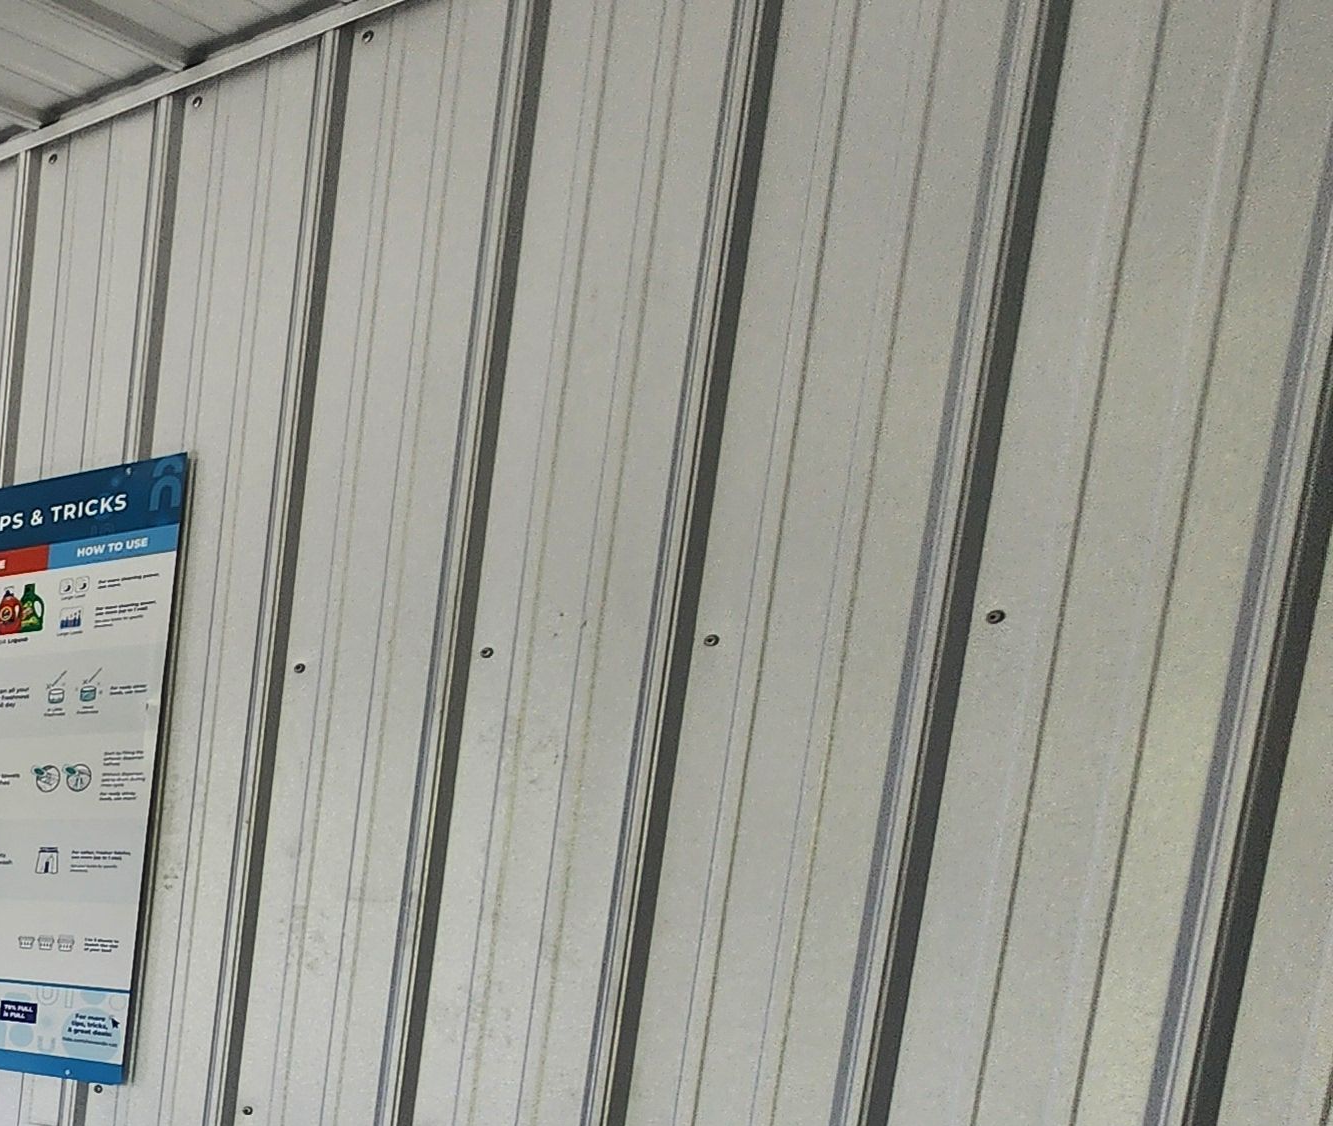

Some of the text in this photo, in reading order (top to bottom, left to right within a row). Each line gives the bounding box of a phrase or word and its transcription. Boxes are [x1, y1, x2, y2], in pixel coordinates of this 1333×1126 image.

[30, 509, 44, 526] &
[50, 494, 127, 523] TRICKS
[76, 537, 149, 558] HOW TO USE
